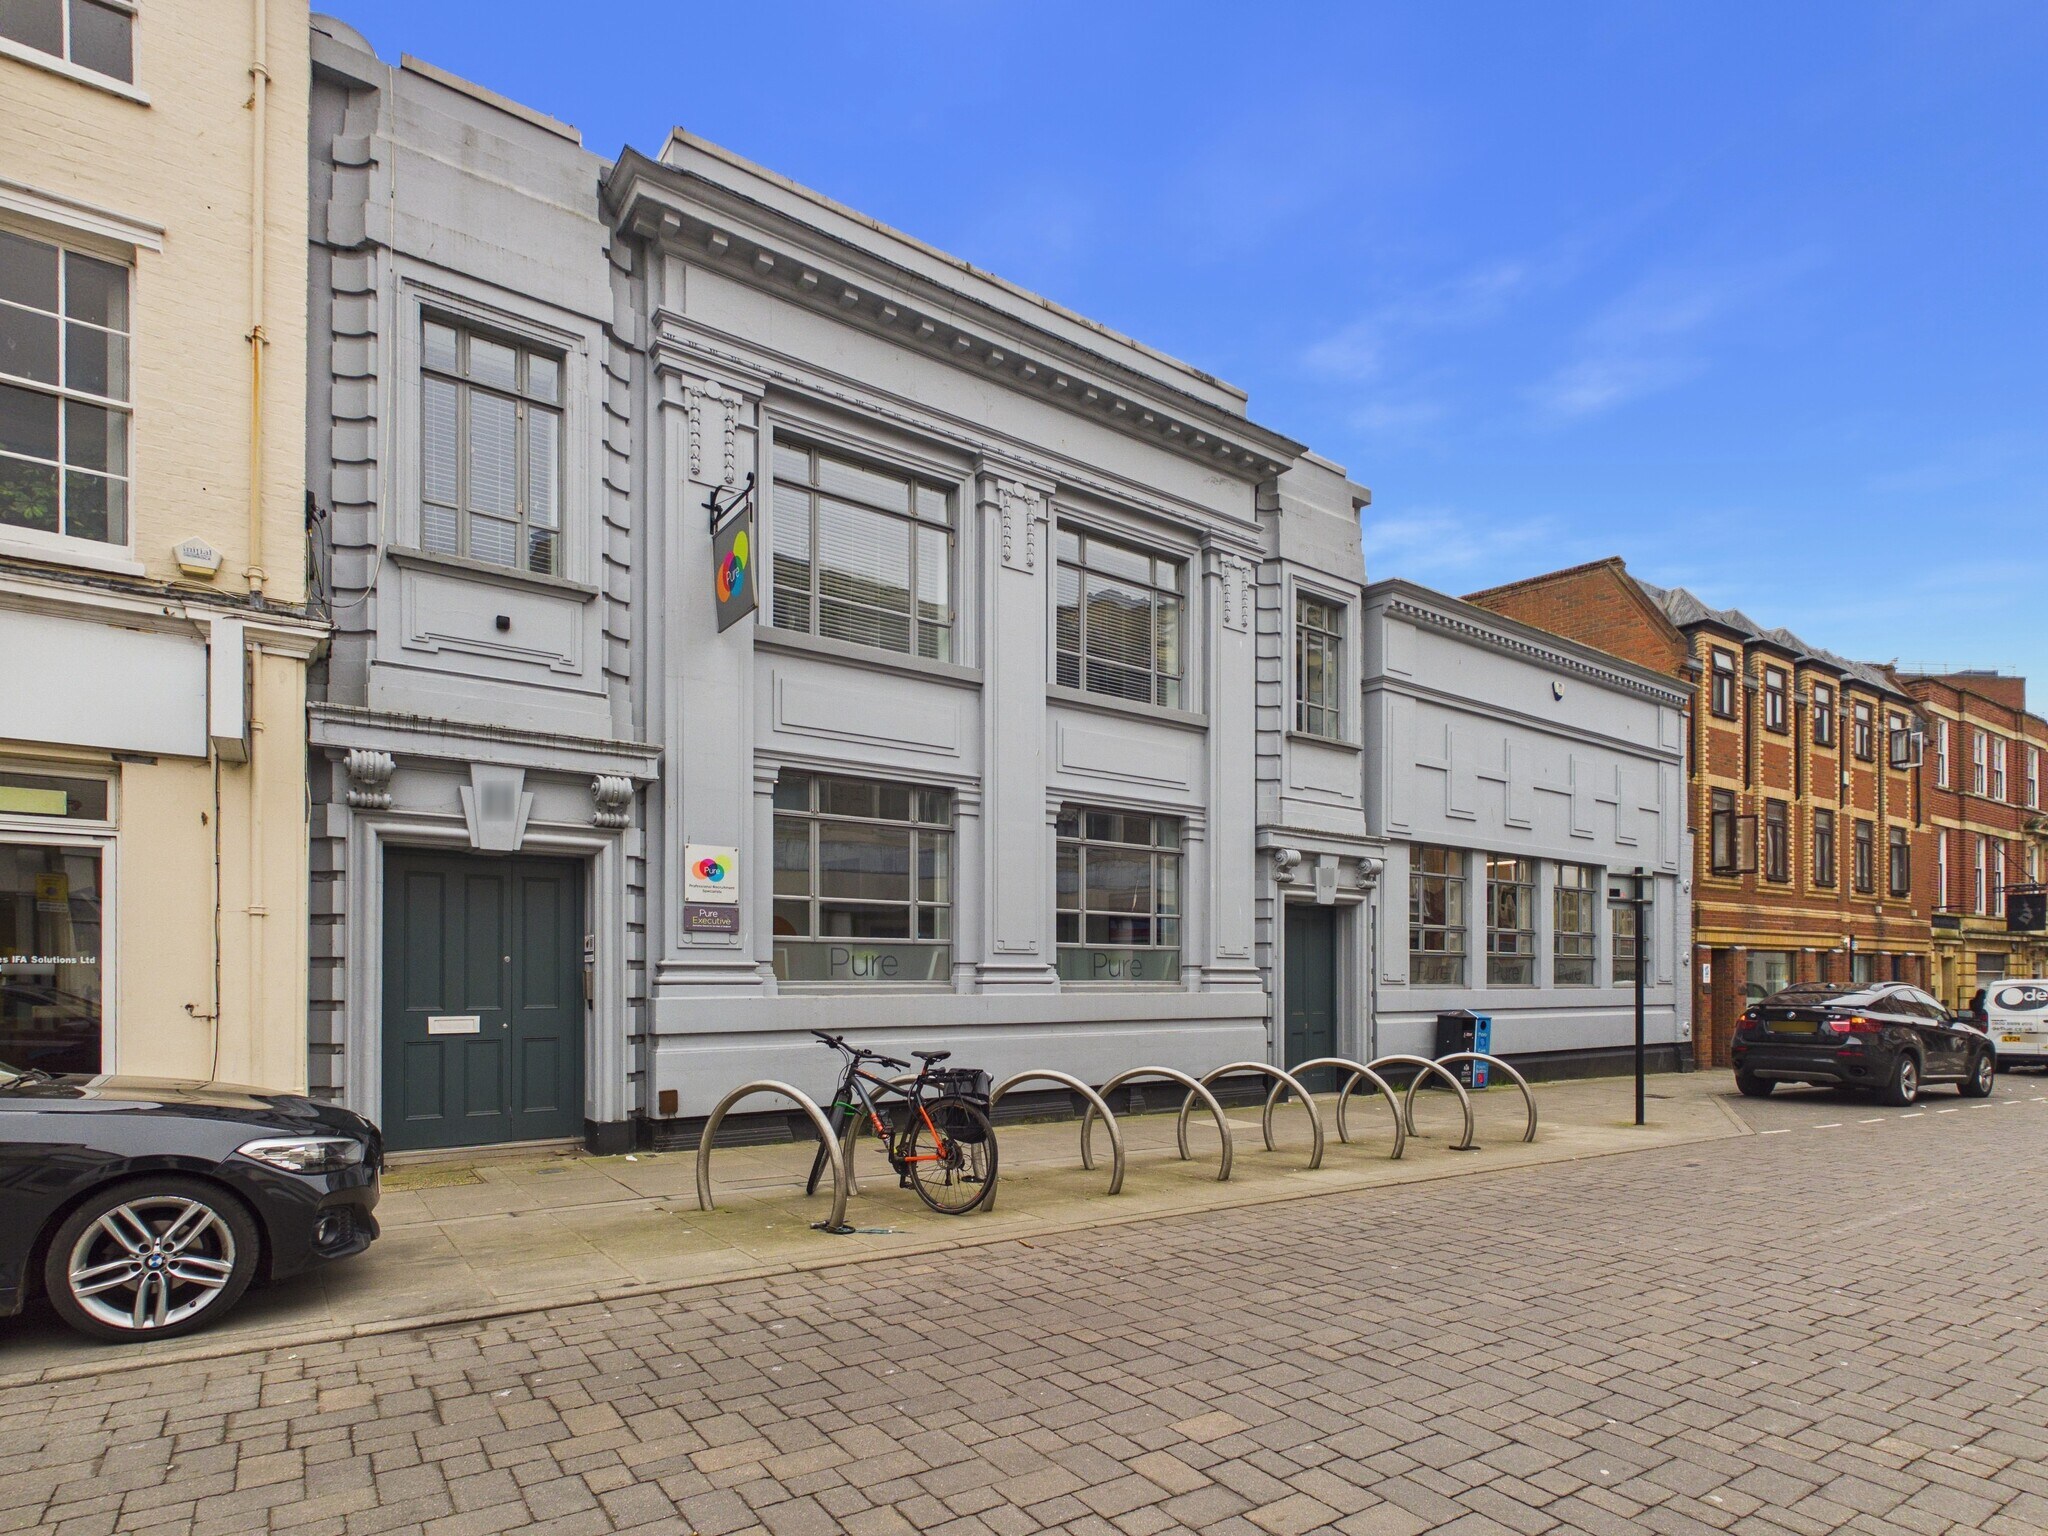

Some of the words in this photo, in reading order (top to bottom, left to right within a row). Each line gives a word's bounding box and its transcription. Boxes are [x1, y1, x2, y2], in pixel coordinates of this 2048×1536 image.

[726, 566, 740, 586] Pure
[704, 866, 721, 875] Pure
[699, 908, 718, 918] Pure
[692, 916, 731, 926] Executive
[12, 955, 27, 964] IFA
[31, 955, 77, 964] Solutions
[80, 956, 96, 964] Ltd
[830, 947, 899, 977] Pure
[1093, 952, 1142, 978] Pure
